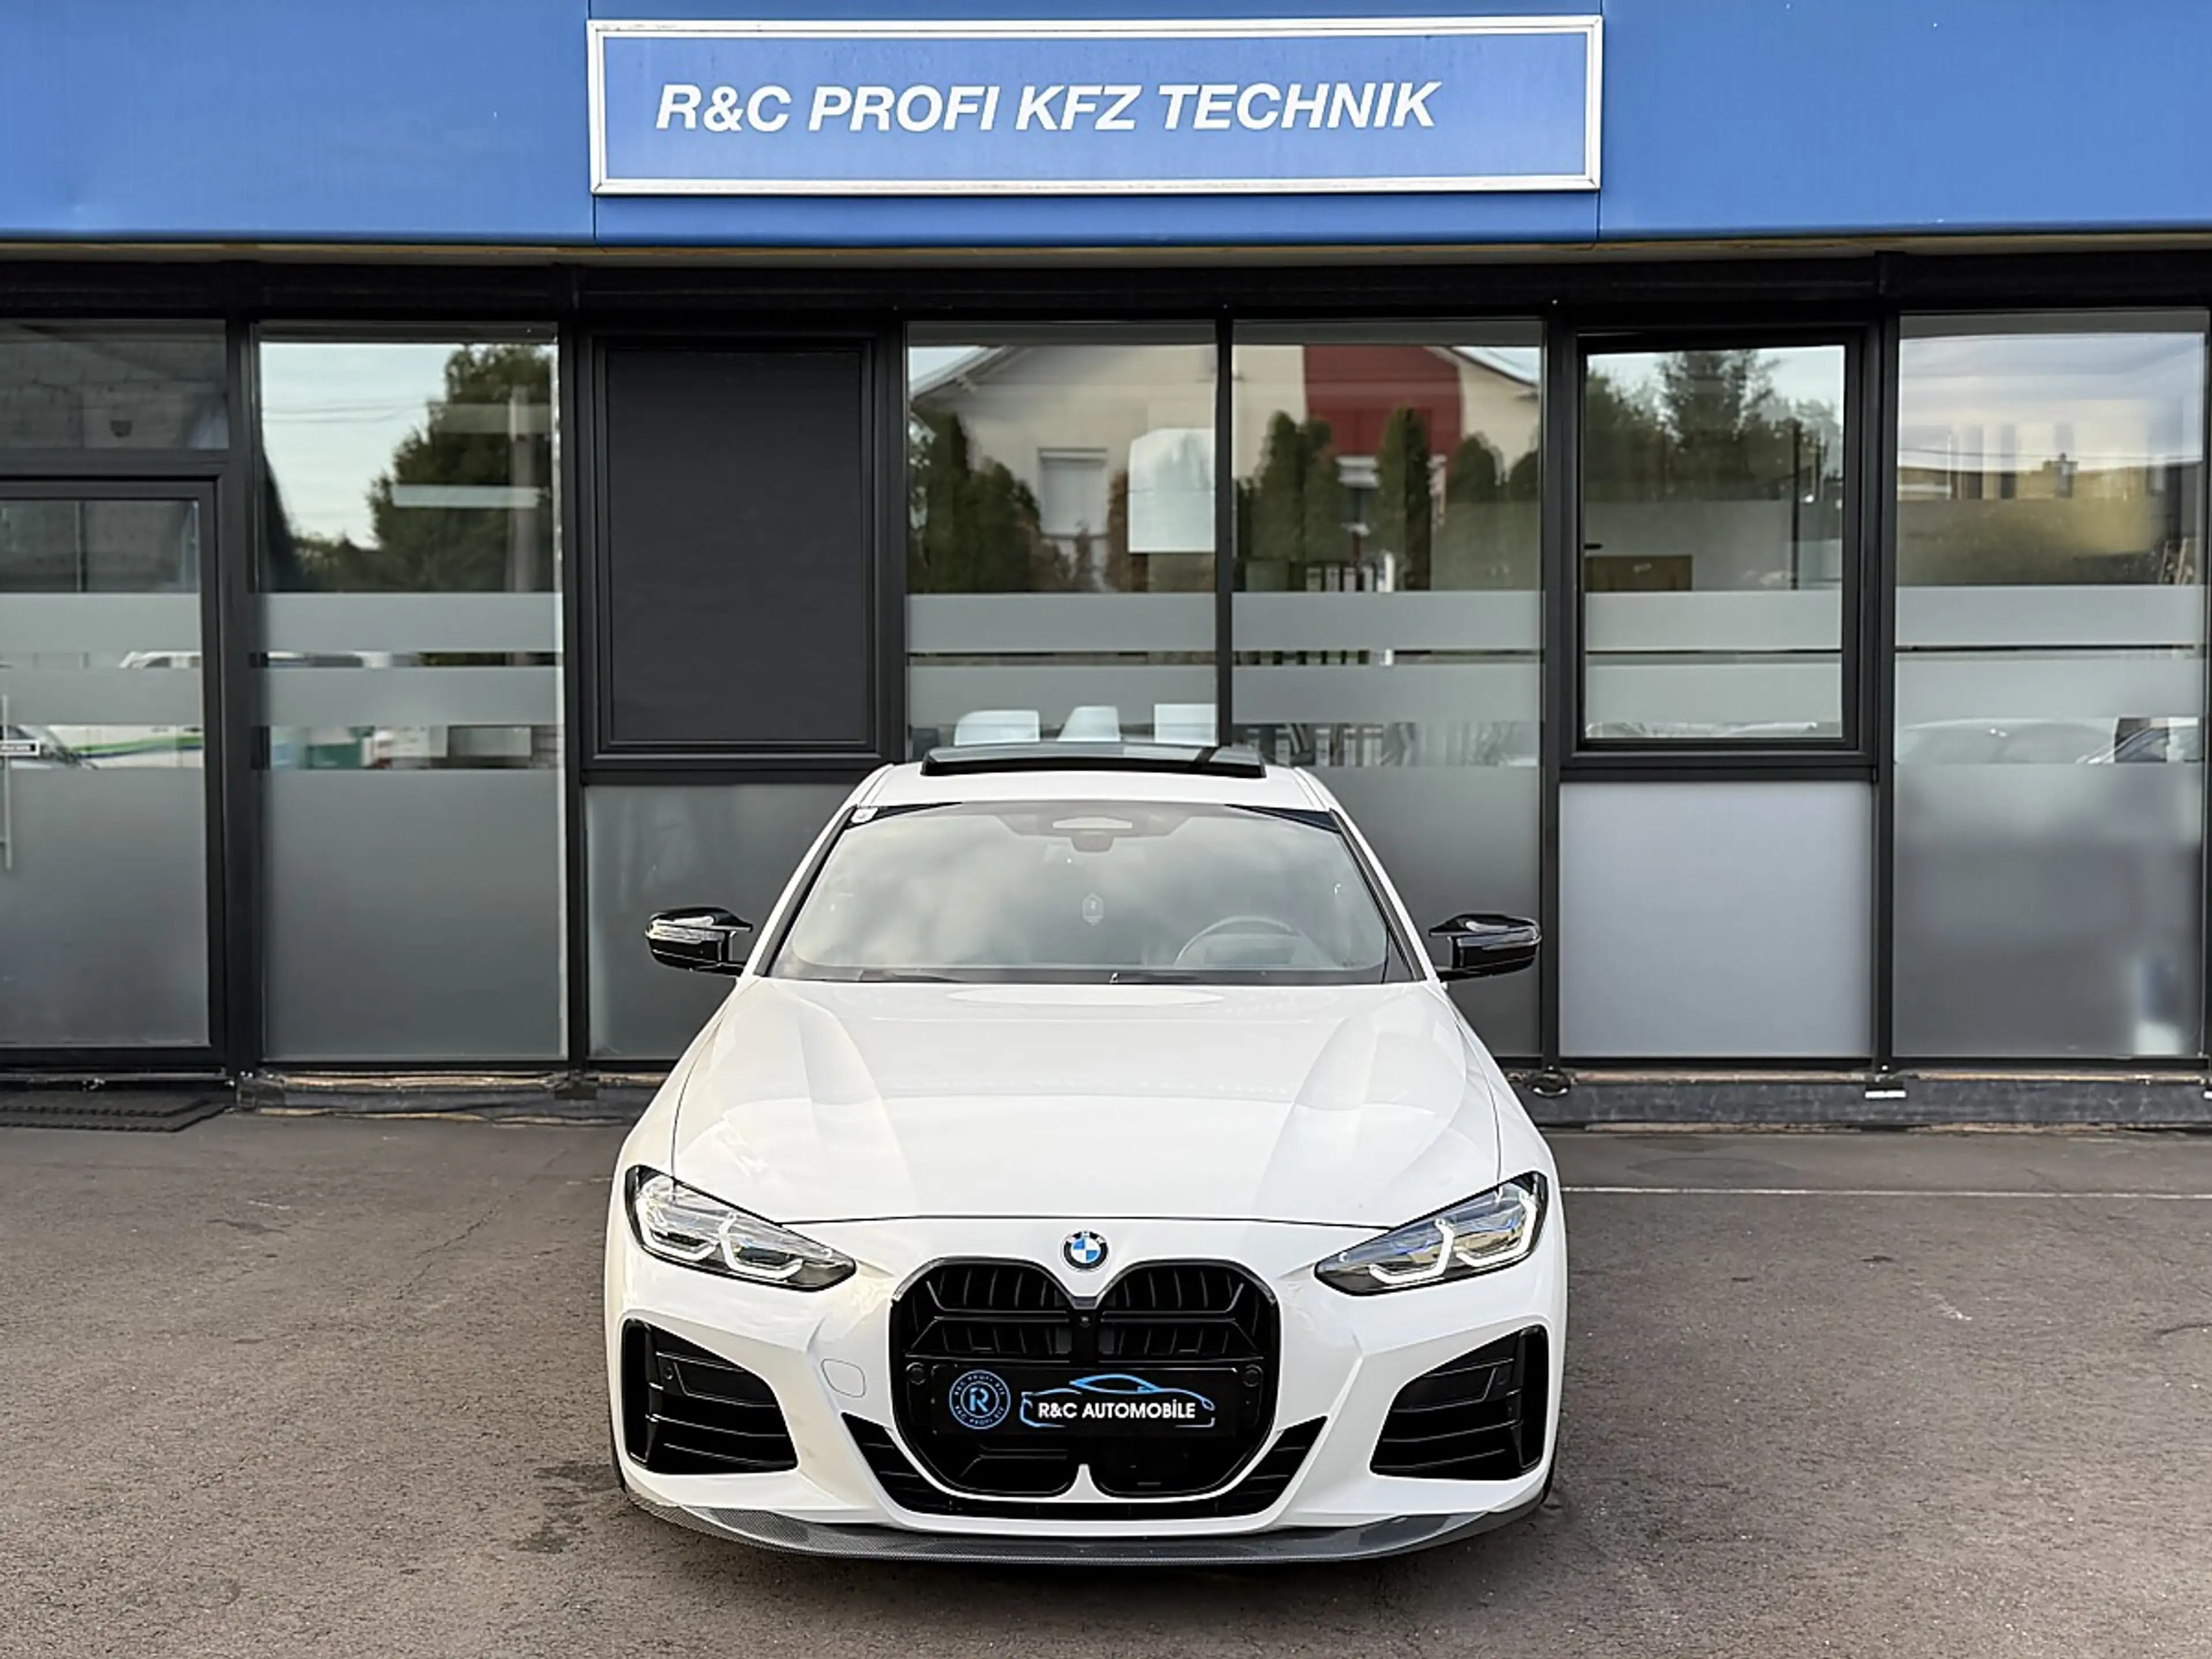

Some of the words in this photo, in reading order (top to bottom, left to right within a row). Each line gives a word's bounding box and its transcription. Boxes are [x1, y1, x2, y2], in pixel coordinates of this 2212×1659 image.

[657, 85, 791, 131] R&C
[809, 85, 1000, 131] PROFI
[1016, 85, 1142, 130] KFZ
[1160, 82, 1441, 130] TECHNIK
[1038, 1402, 1077, 1419] R&C
